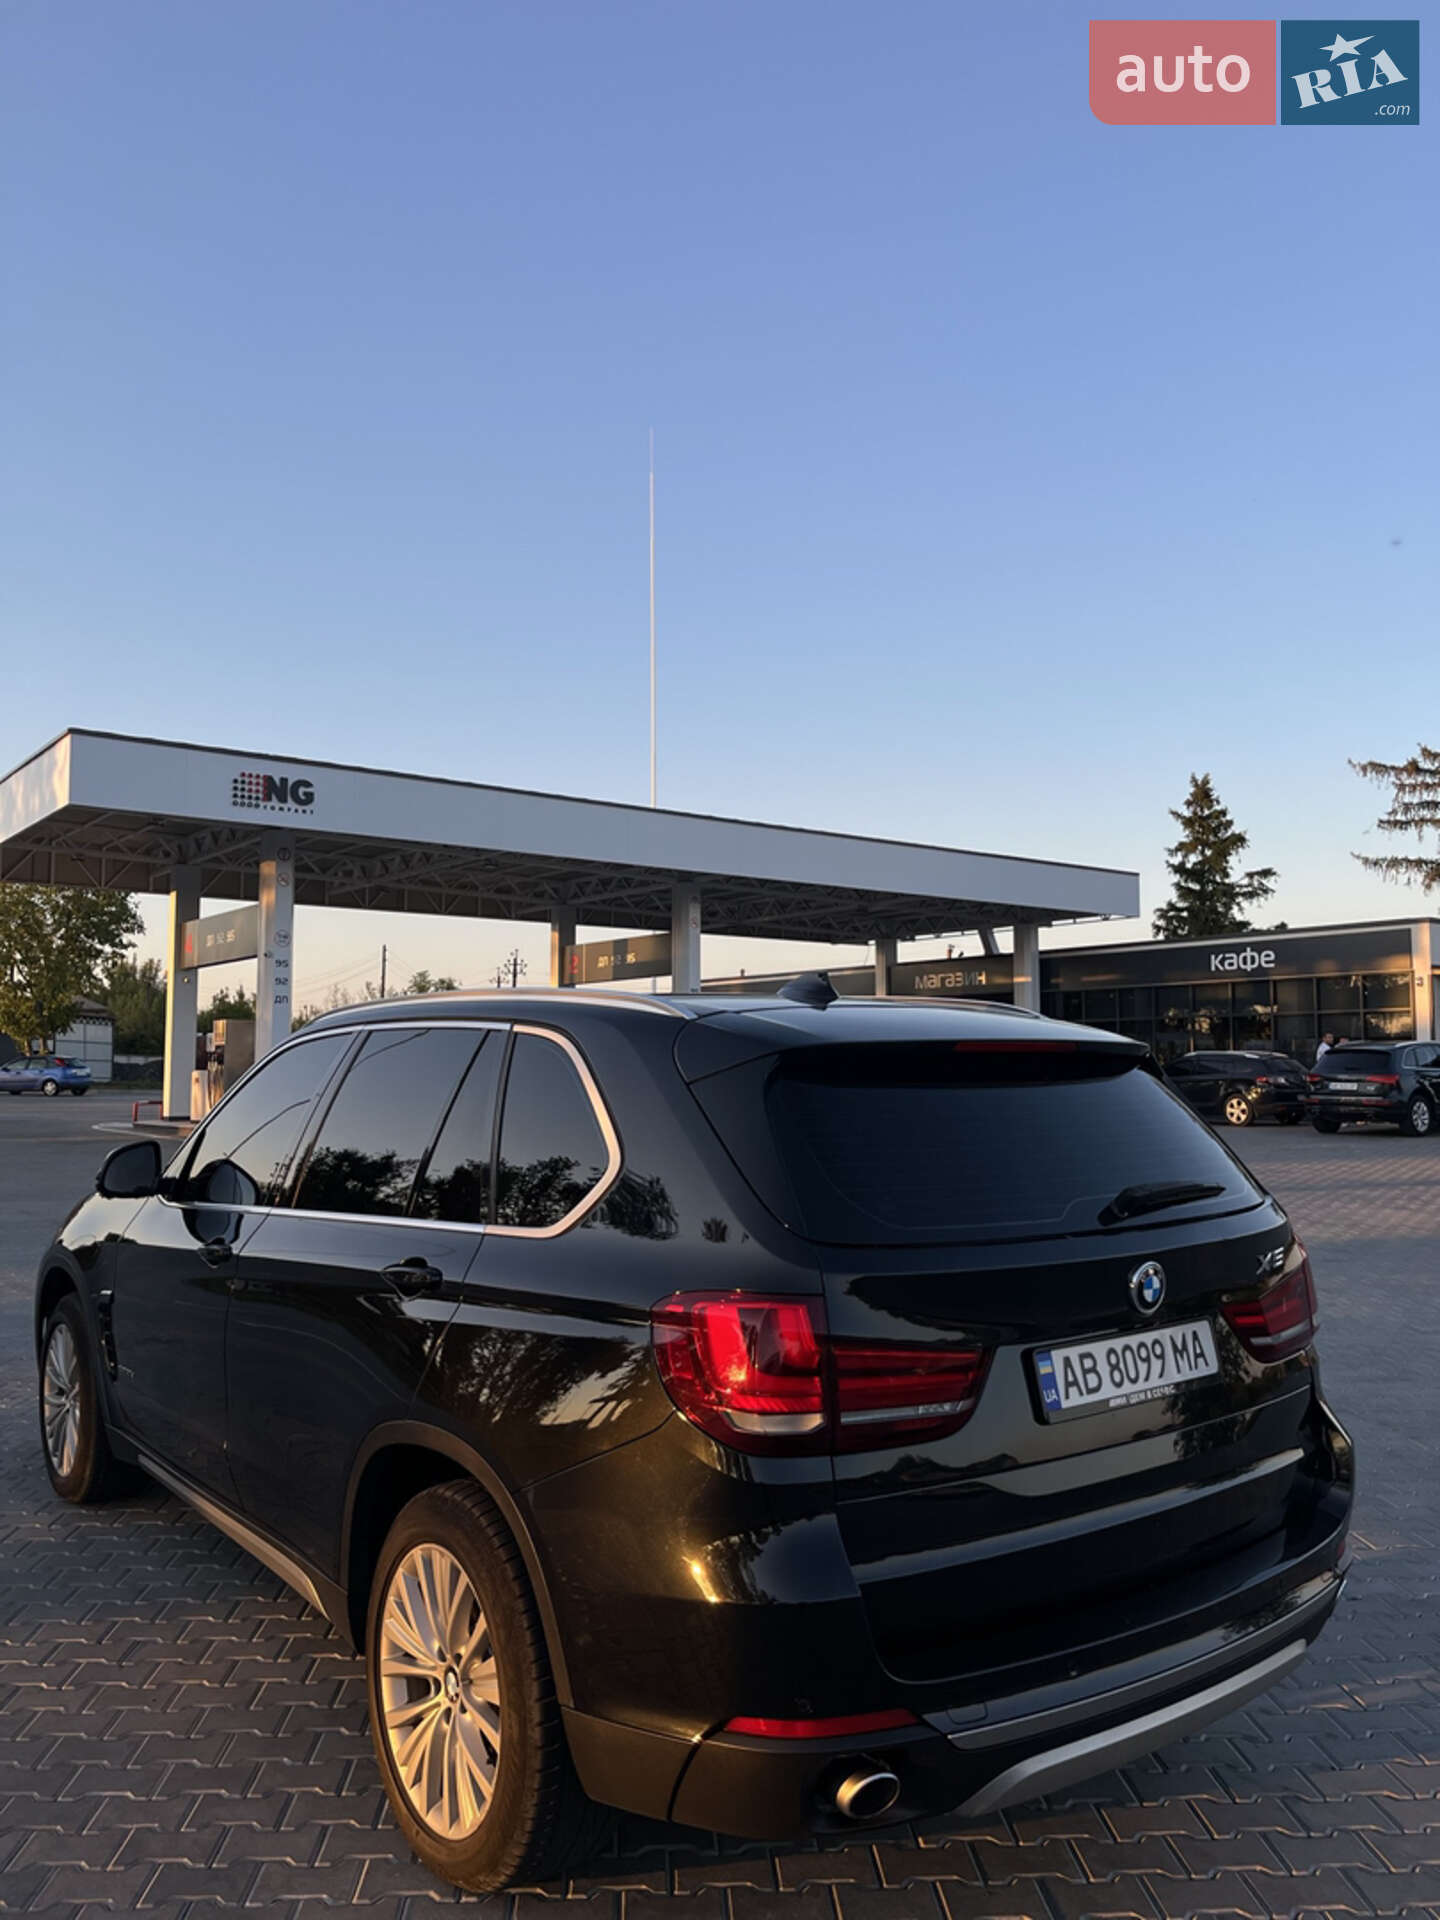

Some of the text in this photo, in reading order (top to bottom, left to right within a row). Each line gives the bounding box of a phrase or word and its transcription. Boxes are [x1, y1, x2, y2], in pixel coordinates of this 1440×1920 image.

[262, 774, 316, 806] NG
[274, 959, 289, 968] 95
[1210, 946, 1276, 972] кафе
[274, 977, 289, 986] 92
[914, 970, 987, 990] магазин
[1062, 1351, 1103, 1400] AB
[1106, 1338, 1166, 1389] 8099
[1169, 1329, 1210, 1374] MA
[1043, 1389, 1059, 1403] UA
